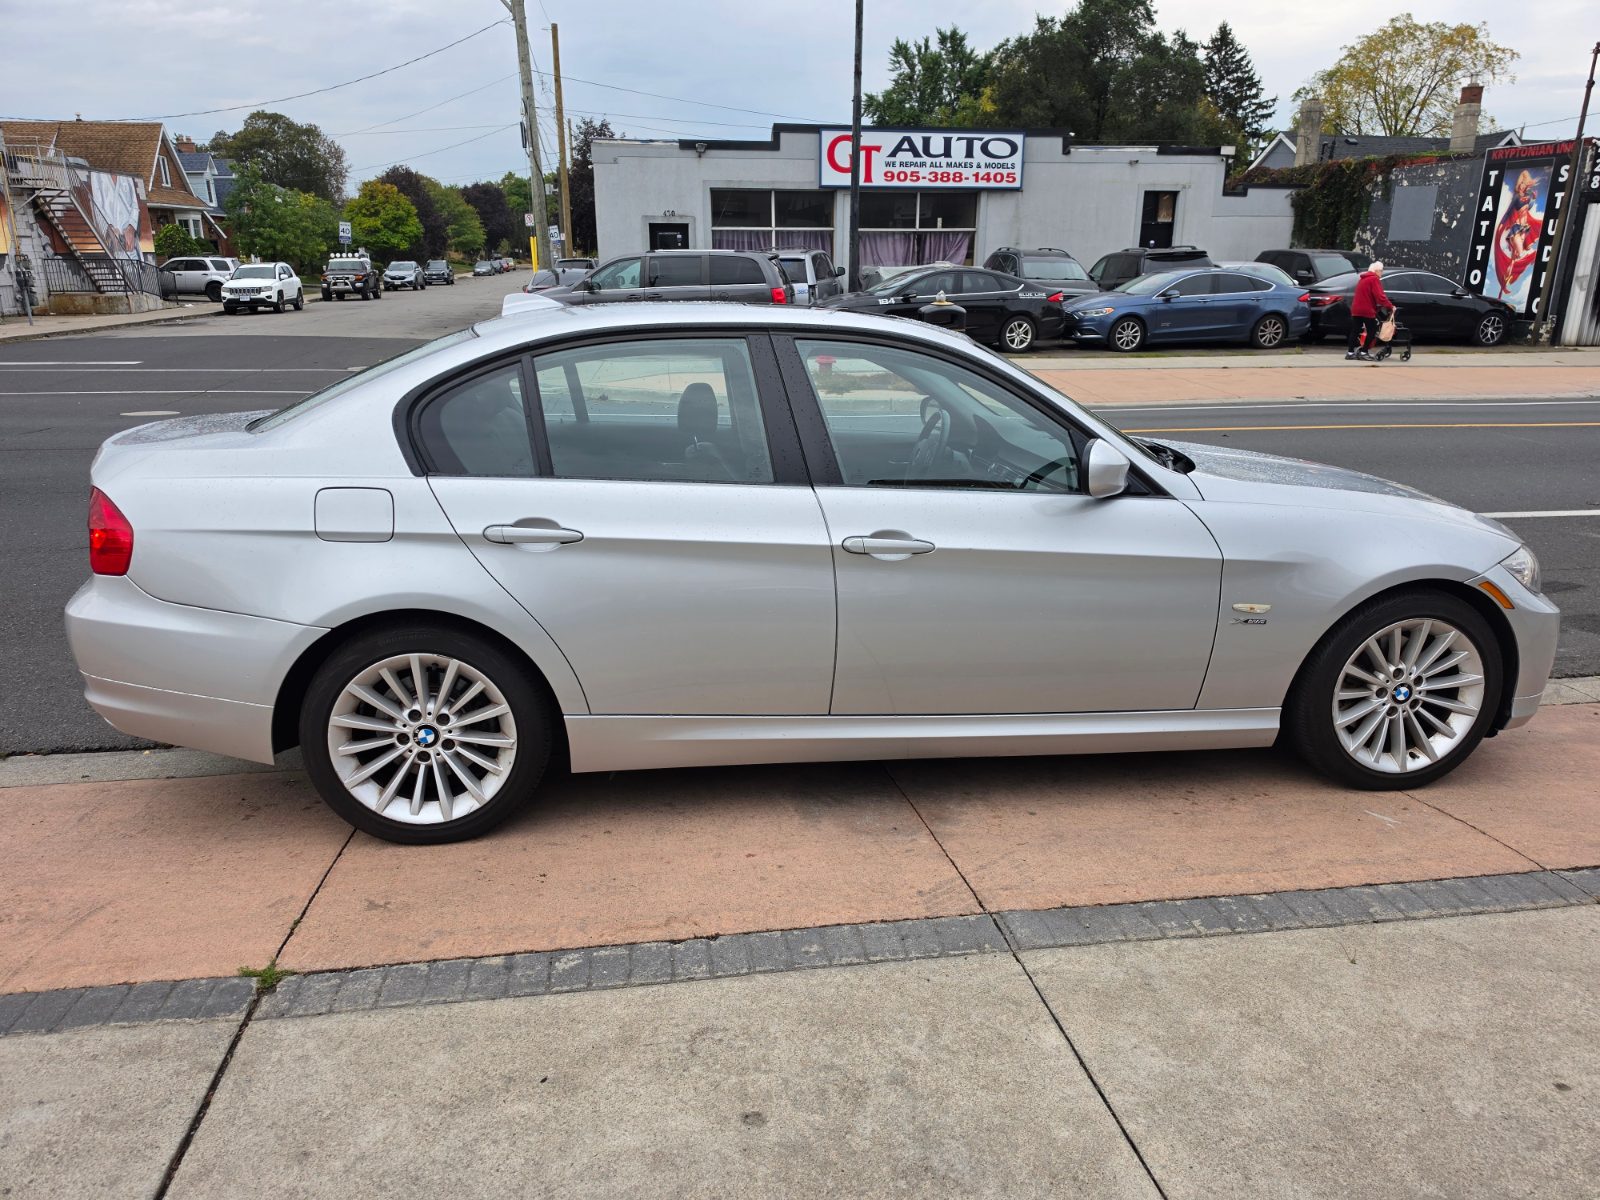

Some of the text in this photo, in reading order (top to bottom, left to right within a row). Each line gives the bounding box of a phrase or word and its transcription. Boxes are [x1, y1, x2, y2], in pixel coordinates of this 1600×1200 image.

[826, 134, 1019, 183] GT AUTO
[1492, 144, 1554, 160] KRYPTONIAN
[984, 162, 1016, 170] MODELS
[883, 170, 1017, 184] 905-388-1405
[1469, 170, 1499, 285] TATTO
